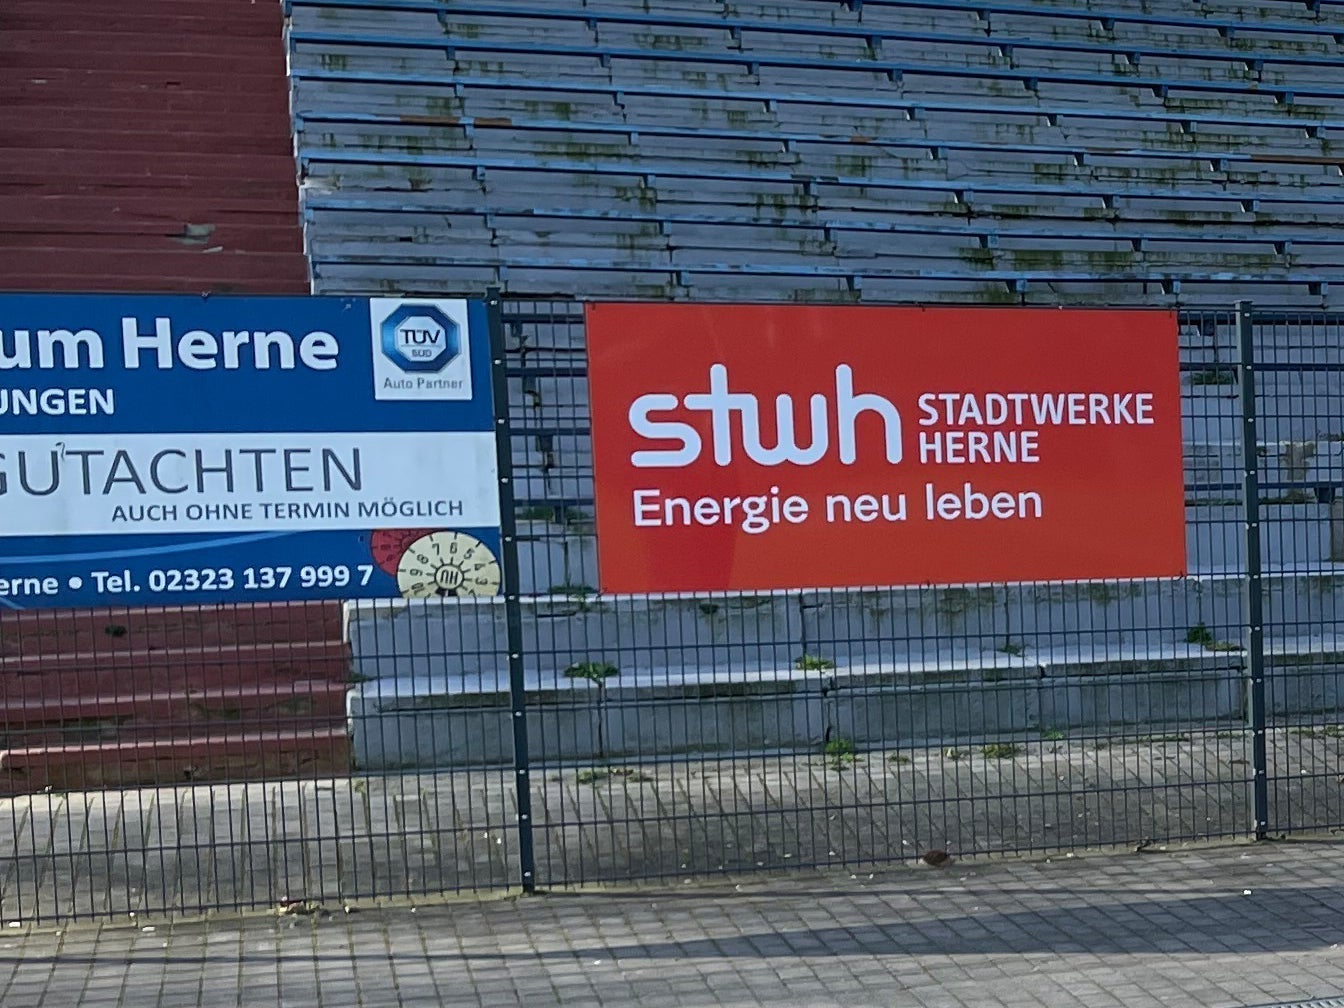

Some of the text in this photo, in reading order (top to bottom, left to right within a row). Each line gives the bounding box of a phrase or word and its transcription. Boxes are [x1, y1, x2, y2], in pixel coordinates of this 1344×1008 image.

[122, 317, 339, 370] Herne
[400, 329, 440, 344] TÜV
[384, 377, 462, 389] Auto Partner
[628, 363, 903, 467] stwh
[918, 393, 1155, 427] STADTWERKE
[919, 431, 1040, 464] HERNE
[112, 497, 464, 522] AUCH OHNE TERMIN MÖGLICH
[633, 482, 1043, 534] Energie neu leben
[92, 570, 140, 593] Tel.
[149, 567, 235, 590] 02323
[243, 566, 292, 589] 137
[300, 565, 350, 588] 999
[357, 564, 374, 587] 7
